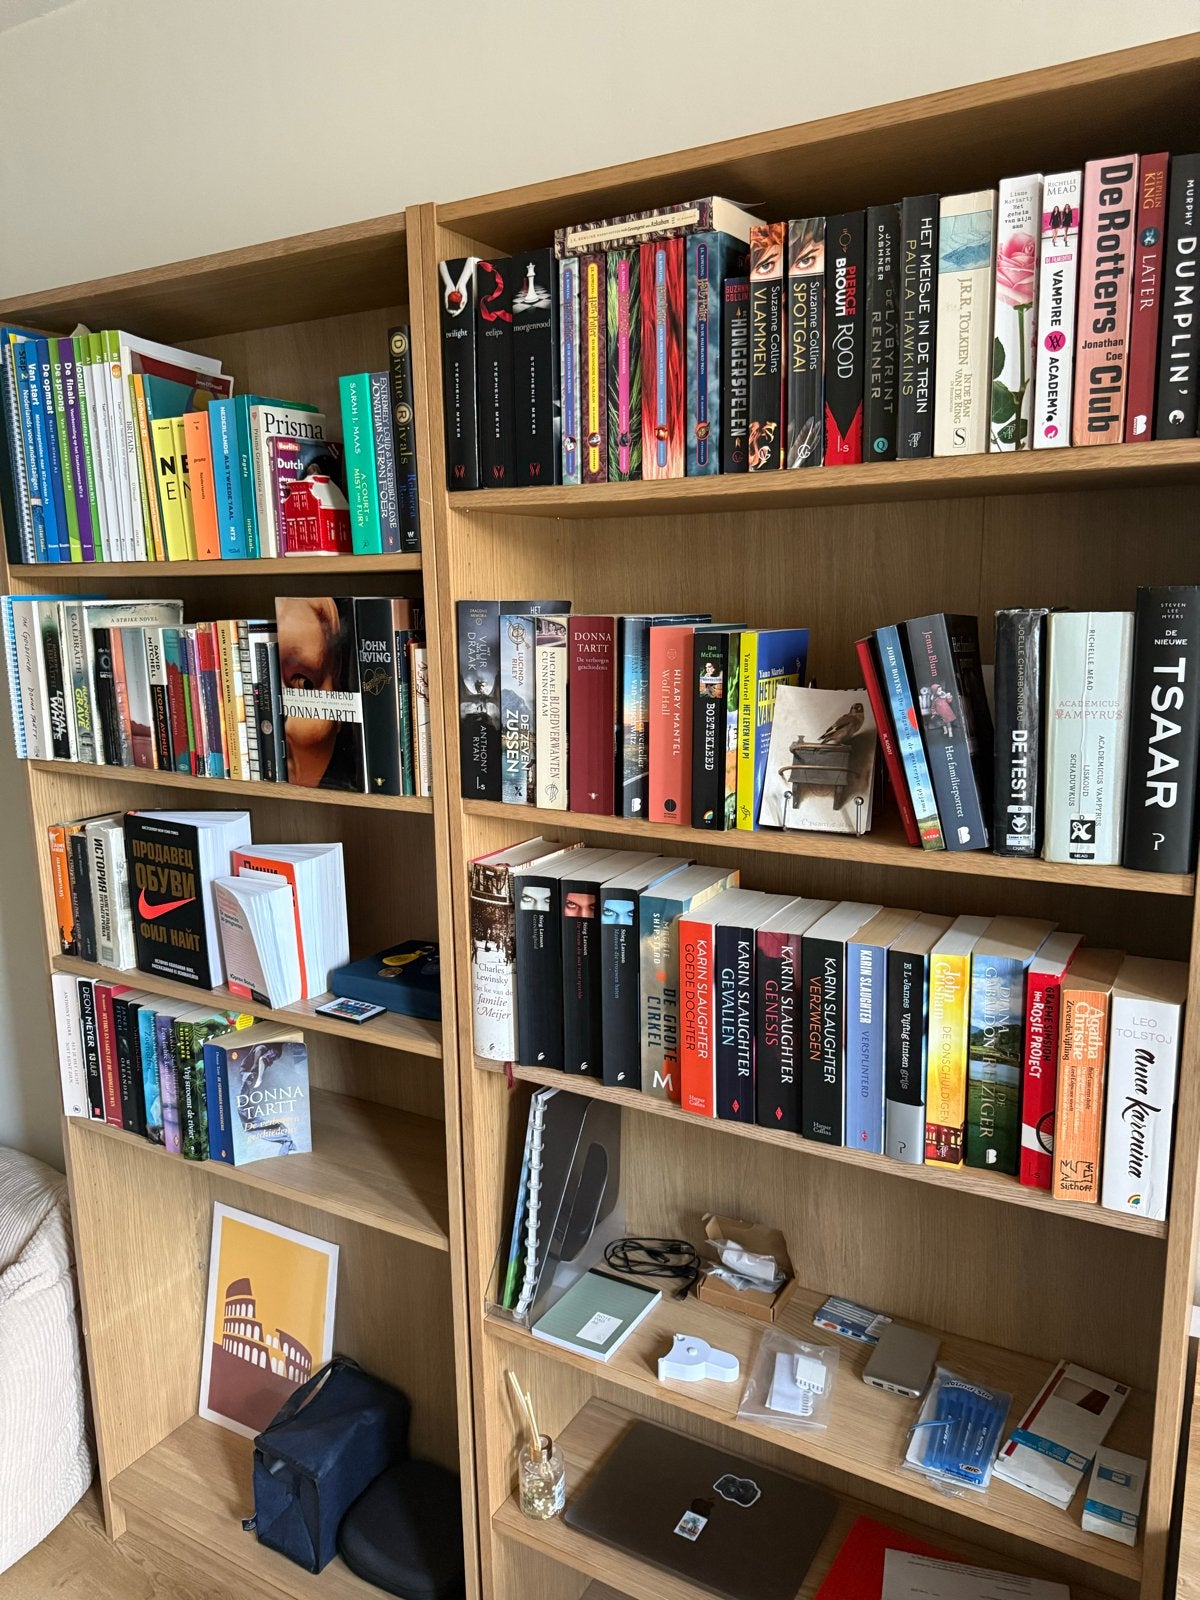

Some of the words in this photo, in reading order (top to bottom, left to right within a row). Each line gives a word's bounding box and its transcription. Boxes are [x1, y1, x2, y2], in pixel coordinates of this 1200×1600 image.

[1047, 184, 1077, 196] MEAD
[1099, 162, 1134, 206] De
[1142, 173, 1156, 210] KING
[1184, 180, 1194, 226] MURPHY
[920, 216, 932, 248] HET
[904, 240, 917, 300] PAULA
[918, 255, 931, 315] MEISJE
[1092, 211, 1132, 334] Rotters
[1140, 254, 1156, 310] LATER
[846, 265, 856, 316] PIERCE
[958, 278, 972, 310] J.R.R.
[513, 319, 550, 332] morgenrood
[771, 286, 780, 332] Suzanne
[752, 287, 767, 377] VLAMMEN
[792, 282, 807, 372] SPOTGAAI
[918, 320, 930, 336] IN
[958, 311, 972, 366] TOLKIEN
[770, 332, 780, 374] Collins
[832, 322, 854, 379] ROOD
[871, 312, 882, 400] RENNER
[902, 311, 916, 396] HAWKINS
[918, 343, 929, 364] DE
[1082, 338, 1124, 350] Jonathan
[28, 363, 37, 381] Van
[43, 364, 50, 377] De
[54, 364, 62, 376] De
[64, 362, 72, 376] De
[392, 338, 407, 400] Divine
[730, 318, 748, 438] HONGERSPELEN
[32, 384, 40, 406] start
[44, 378, 54, 414] opmaat
[56, 378, 66, 412] sprong
[66, 378, 75, 405] finale
[372, 379, 383, 432] JONATHAN
[916, 368, 928, 414] TREIN
[1088, 365, 1122, 433] Club
[126, 421, 134, 454] BRITAIN
[264, 412, 324, 440] Prisma
[354, 426, 362, 454] MAAS
[398, 404, 413, 464] Rivals
[277, 458, 304, 470] Dutch
[376, 434, 386, 478] SAFRAN
[70, 613, 82, 674] GALBRAITH
[222, 646, 227, 656] TO
[362, 638, 387, 651] JOHN
[466, 632, 477, 670] DRAAK
[574, 632, 612, 642] DONNA
[577, 644, 609, 654] TARTT
[922, 631, 933, 658] Jenna
[1088, 630, 1096, 665] RICHELLE
[1154, 638, 1188, 646] NIEUWE
[148, 637, 156, 678] MITCHELL
[360, 650, 392, 663] IRVING
[926, 656, 938, 677] Blum
[673, 670, 682, 712] HILARY
[1016, 657, 1025, 722] CHARBONNEAU
[1086, 669, 1094, 691] MEAD
[75, 688, 86, 728] GRAVE
[283, 704, 320, 720] DONNA
[324, 706, 356, 722] TARTT
[1059, 700, 1120, 708] ACADEMICUS
[506, 710, 520, 773] ZUSSEN
[672, 714, 682, 756] MANTEL
[704, 702, 716, 771] BOETEKLEED
[742, 718, 750, 736] LEVEN
[1011, 730, 1028, 753] DE
[1144, 656, 1187, 809] TSAAR
[742, 738, 750, 750] VAN
[742, 752, 749, 760] PI
[944, 745, 956, 761] Het
[947, 762, 964, 818] familieportret
[1011, 756, 1028, 801] TEST
[94, 838, 108, 893] ИСТОРИЯ
[132, 839, 194, 870] ПРОДАВЕЦ
[135, 862, 196, 899] ОБУВИ
[140, 922, 168, 944] ФИЛ
[171, 928, 200, 952] НАЙТ
[478, 963, 506, 974] Charles
[737, 940, 750, 988] KARIN
[780, 945, 794, 992] KARIN
[824, 956, 836, 1002] KARIN
[904, 962, 912, 970] E
[82, 986, 92, 1014] DEON
[477, 994, 508, 1008] familie
[721, 968, 735, 1047] GEVALLEN
[902, 978, 912, 1008] James
[1034, 991, 1042, 1002] Het
[476, 1006, 512, 1022] Meijer
[764, 980, 778, 1046] GENESIS
[809, 976, 822, 1062] VERZWEGEN
[900, 1012, 911, 1040] Vijftig
[1030, 1002, 1043, 1032] ROSIE
[1132, 1016, 1157, 1028] LEO
[86, 1016, 95, 1048] MEYER
[737, 990, 750, 1078] SLAUGHTER
[780, 995, 794, 1084] SLAUGHTER
[823, 1003, 836, 1084] SLAUGHTER
[1087, 1006, 1104, 1060] Agatha
[1116, 1028, 1172, 1045] TOLSTOJ
[88, 1053, 95, 1063] 13
[90, 1064, 98, 1077] UUR
[900, 1041, 910, 1068] tinten
[1028, 1034, 1043, 1078] PROJECT
[120, 1058, 128, 1101] OLEANDER
[900, 1068, 909, 1090] grijs
[1134, 1048, 1155, 1096] anna
[236, 1086, 304, 1108] DONNA
[244, 1100, 296, 1120] TARTT
[813, 1122, 832, 1130] Harper
[813, 1126, 832, 1136] Collins
[1122, 1096, 1162, 1179] Karenina
